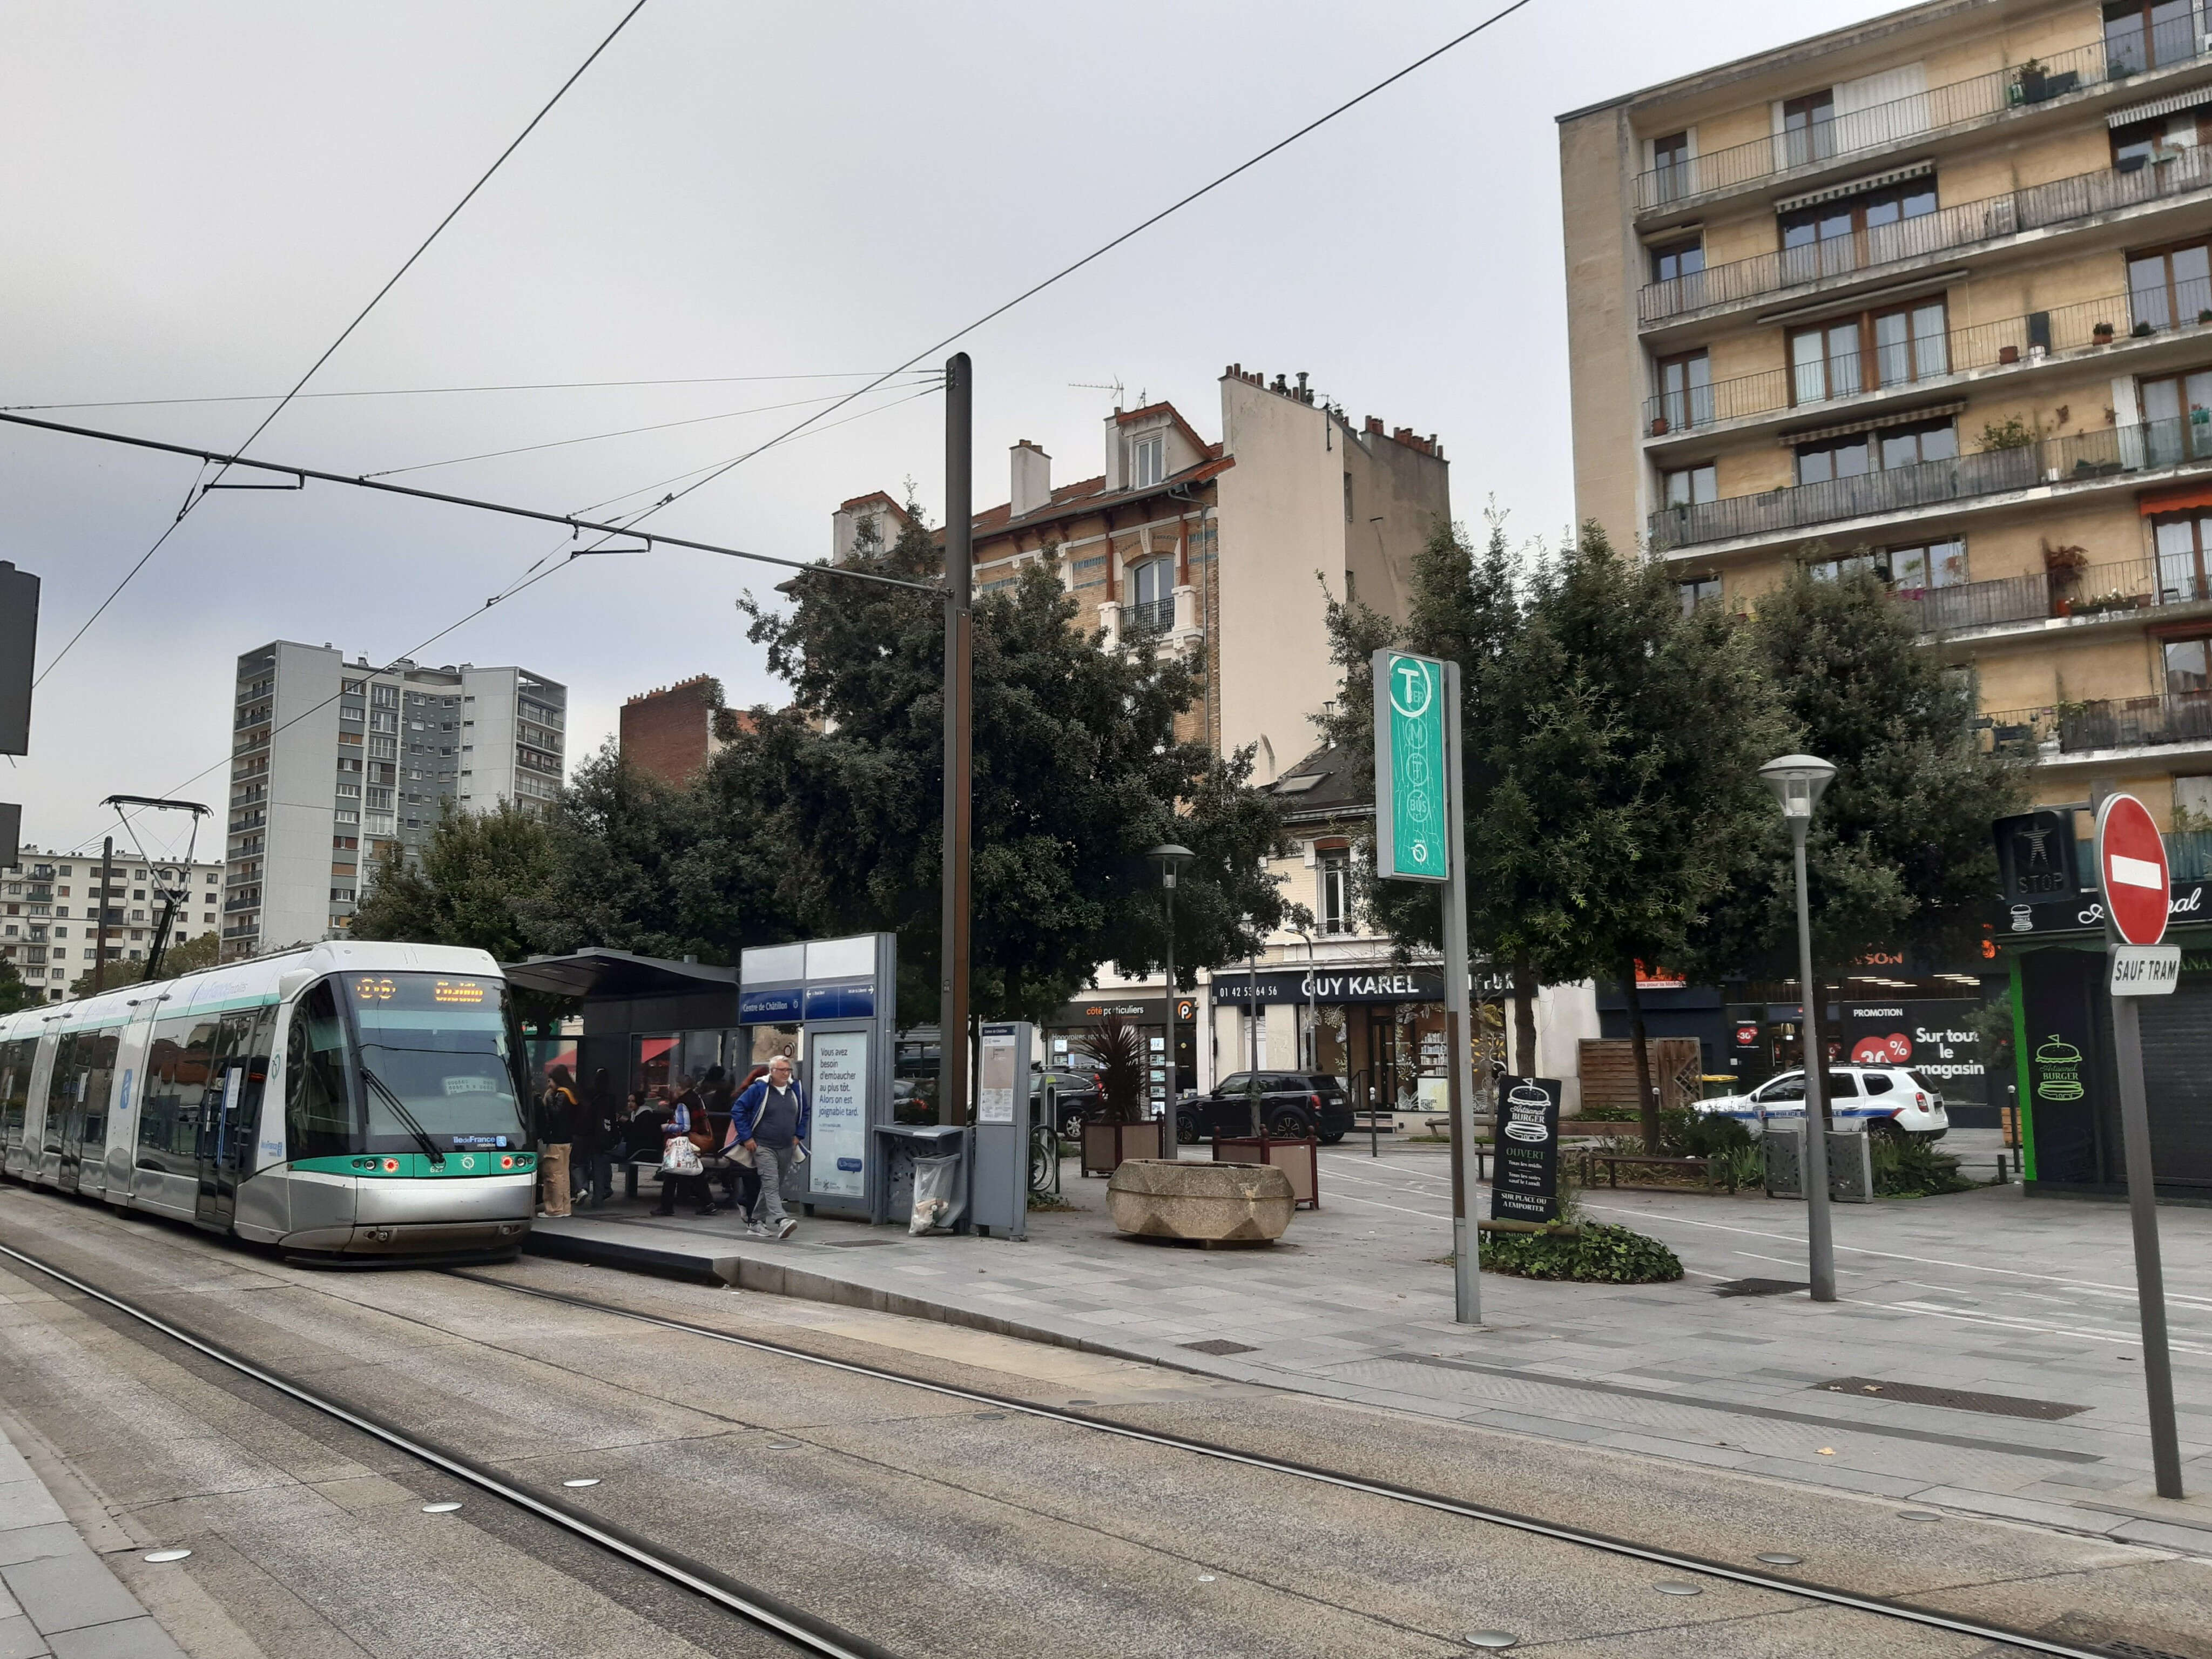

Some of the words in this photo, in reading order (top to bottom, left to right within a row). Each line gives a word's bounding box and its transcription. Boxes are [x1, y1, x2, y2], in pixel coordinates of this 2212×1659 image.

[1410, 723, 1423, 742] M
[1410, 799, 1427, 811] BUS
[2019, 872, 2063, 893] STOP
[2115, 960, 2145, 981] SAUF
[2148, 960, 2177, 981] TRAM
[1220, 988, 1228, 997] 01
[1232, 987, 1240, 997] 42
[1256, 986, 1265, 996] 64
[1269, 986, 1277, 996] 56
[1301, 977, 1343, 996] GUY
[1349, 975, 1419, 995] KAREL
[743, 1003, 757, 1012] Centre
[759, 1002, 765, 1011] de
[1853, 1009, 1903, 1017] PROMOTION
[1916, 1027, 1944, 1043] Sur
[1946, 1029, 1979, 1043] tout
[821, 1048, 834, 1056] Vous
[1890, 1041, 1907, 1055] %
[1939, 1043, 1954, 1058] le
[820, 1059, 838, 1068] besoin
[1916, 1060, 1985, 1079] magasin
[820, 1070, 856, 1080] d'embaucher
[827, 1083, 839, 1094] plus
[840, 1082, 851, 1091] tôt.
[820, 1095, 834, 1103] Alors
[819, 1106, 844, 1118] joignable
[846, 1107, 859, 1116] tard.
[1512, 1112, 1545, 1123] BURGER
[1506, 1148, 1545, 1160] OUVERT
[1515, 1195, 1536, 1203] PLACE
[1508, 1202, 1545, 1212] EMPORTER
